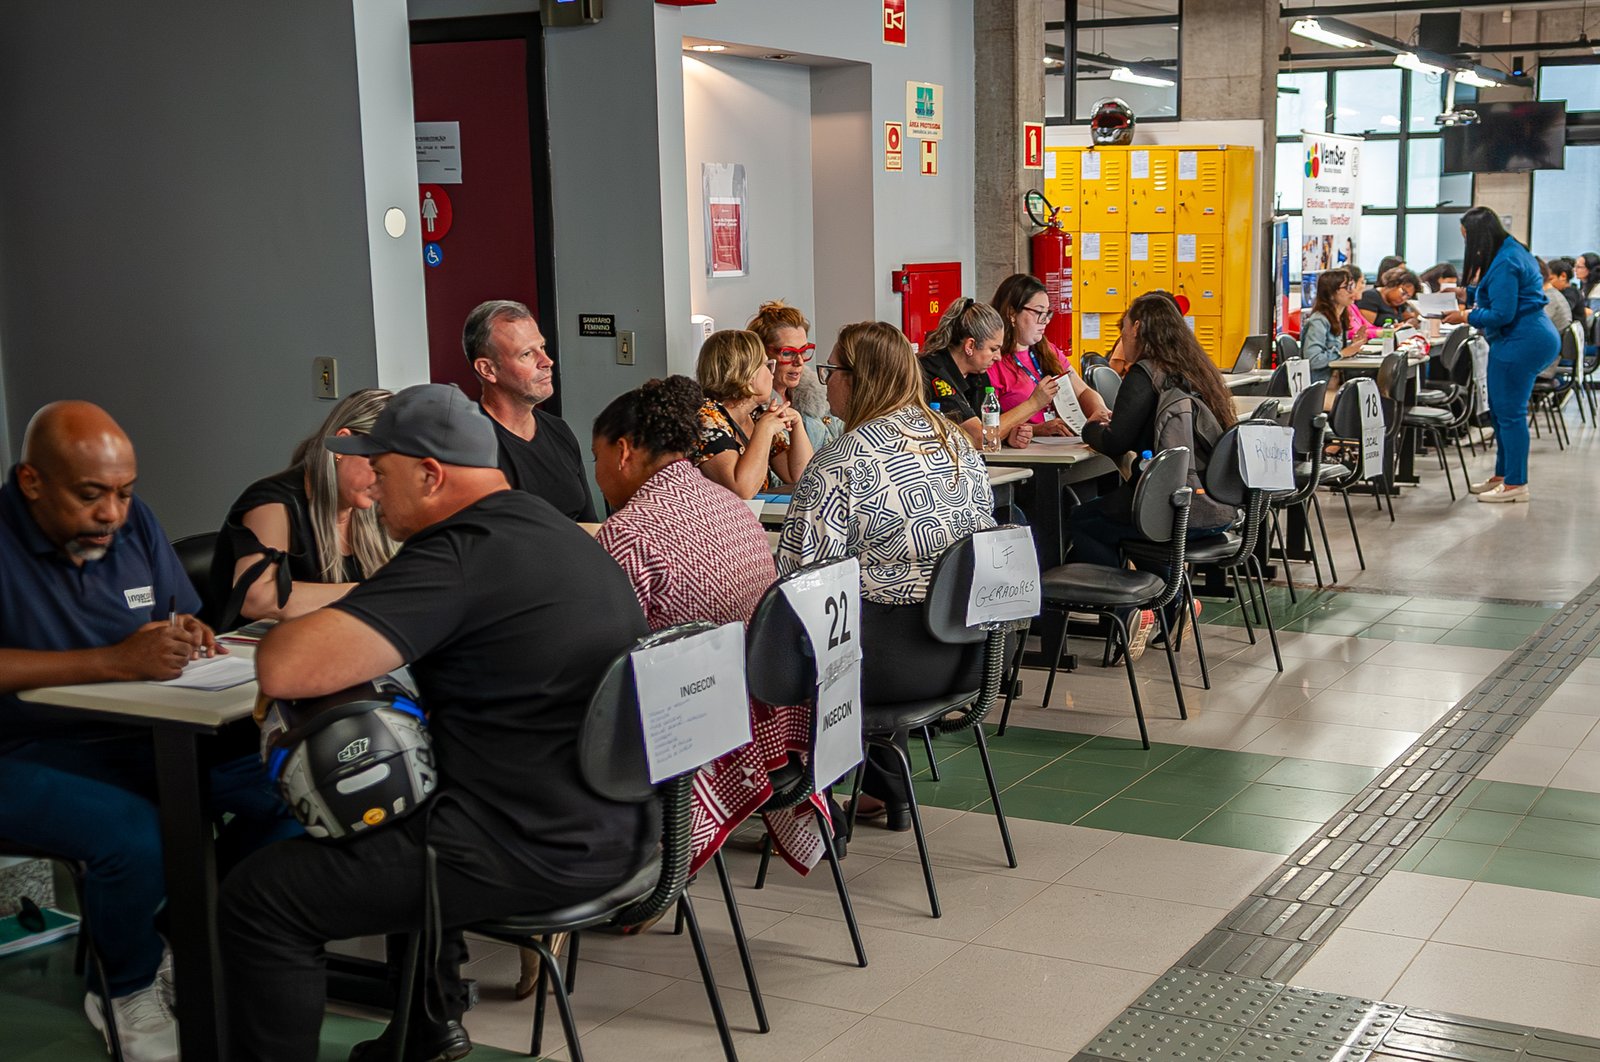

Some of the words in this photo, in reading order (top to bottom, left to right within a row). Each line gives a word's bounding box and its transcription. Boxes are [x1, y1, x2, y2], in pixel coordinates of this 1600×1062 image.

[929, 300, 939, 314] 06
[1292, 372, 1302, 393] 17
[1365, 393, 1378, 418] 18
[975, 580, 1035, 608] GERADORES
[824, 590, 852, 651] 22
[679, 674, 716, 699] INGECON
[822, 699, 853, 732] INGECON
